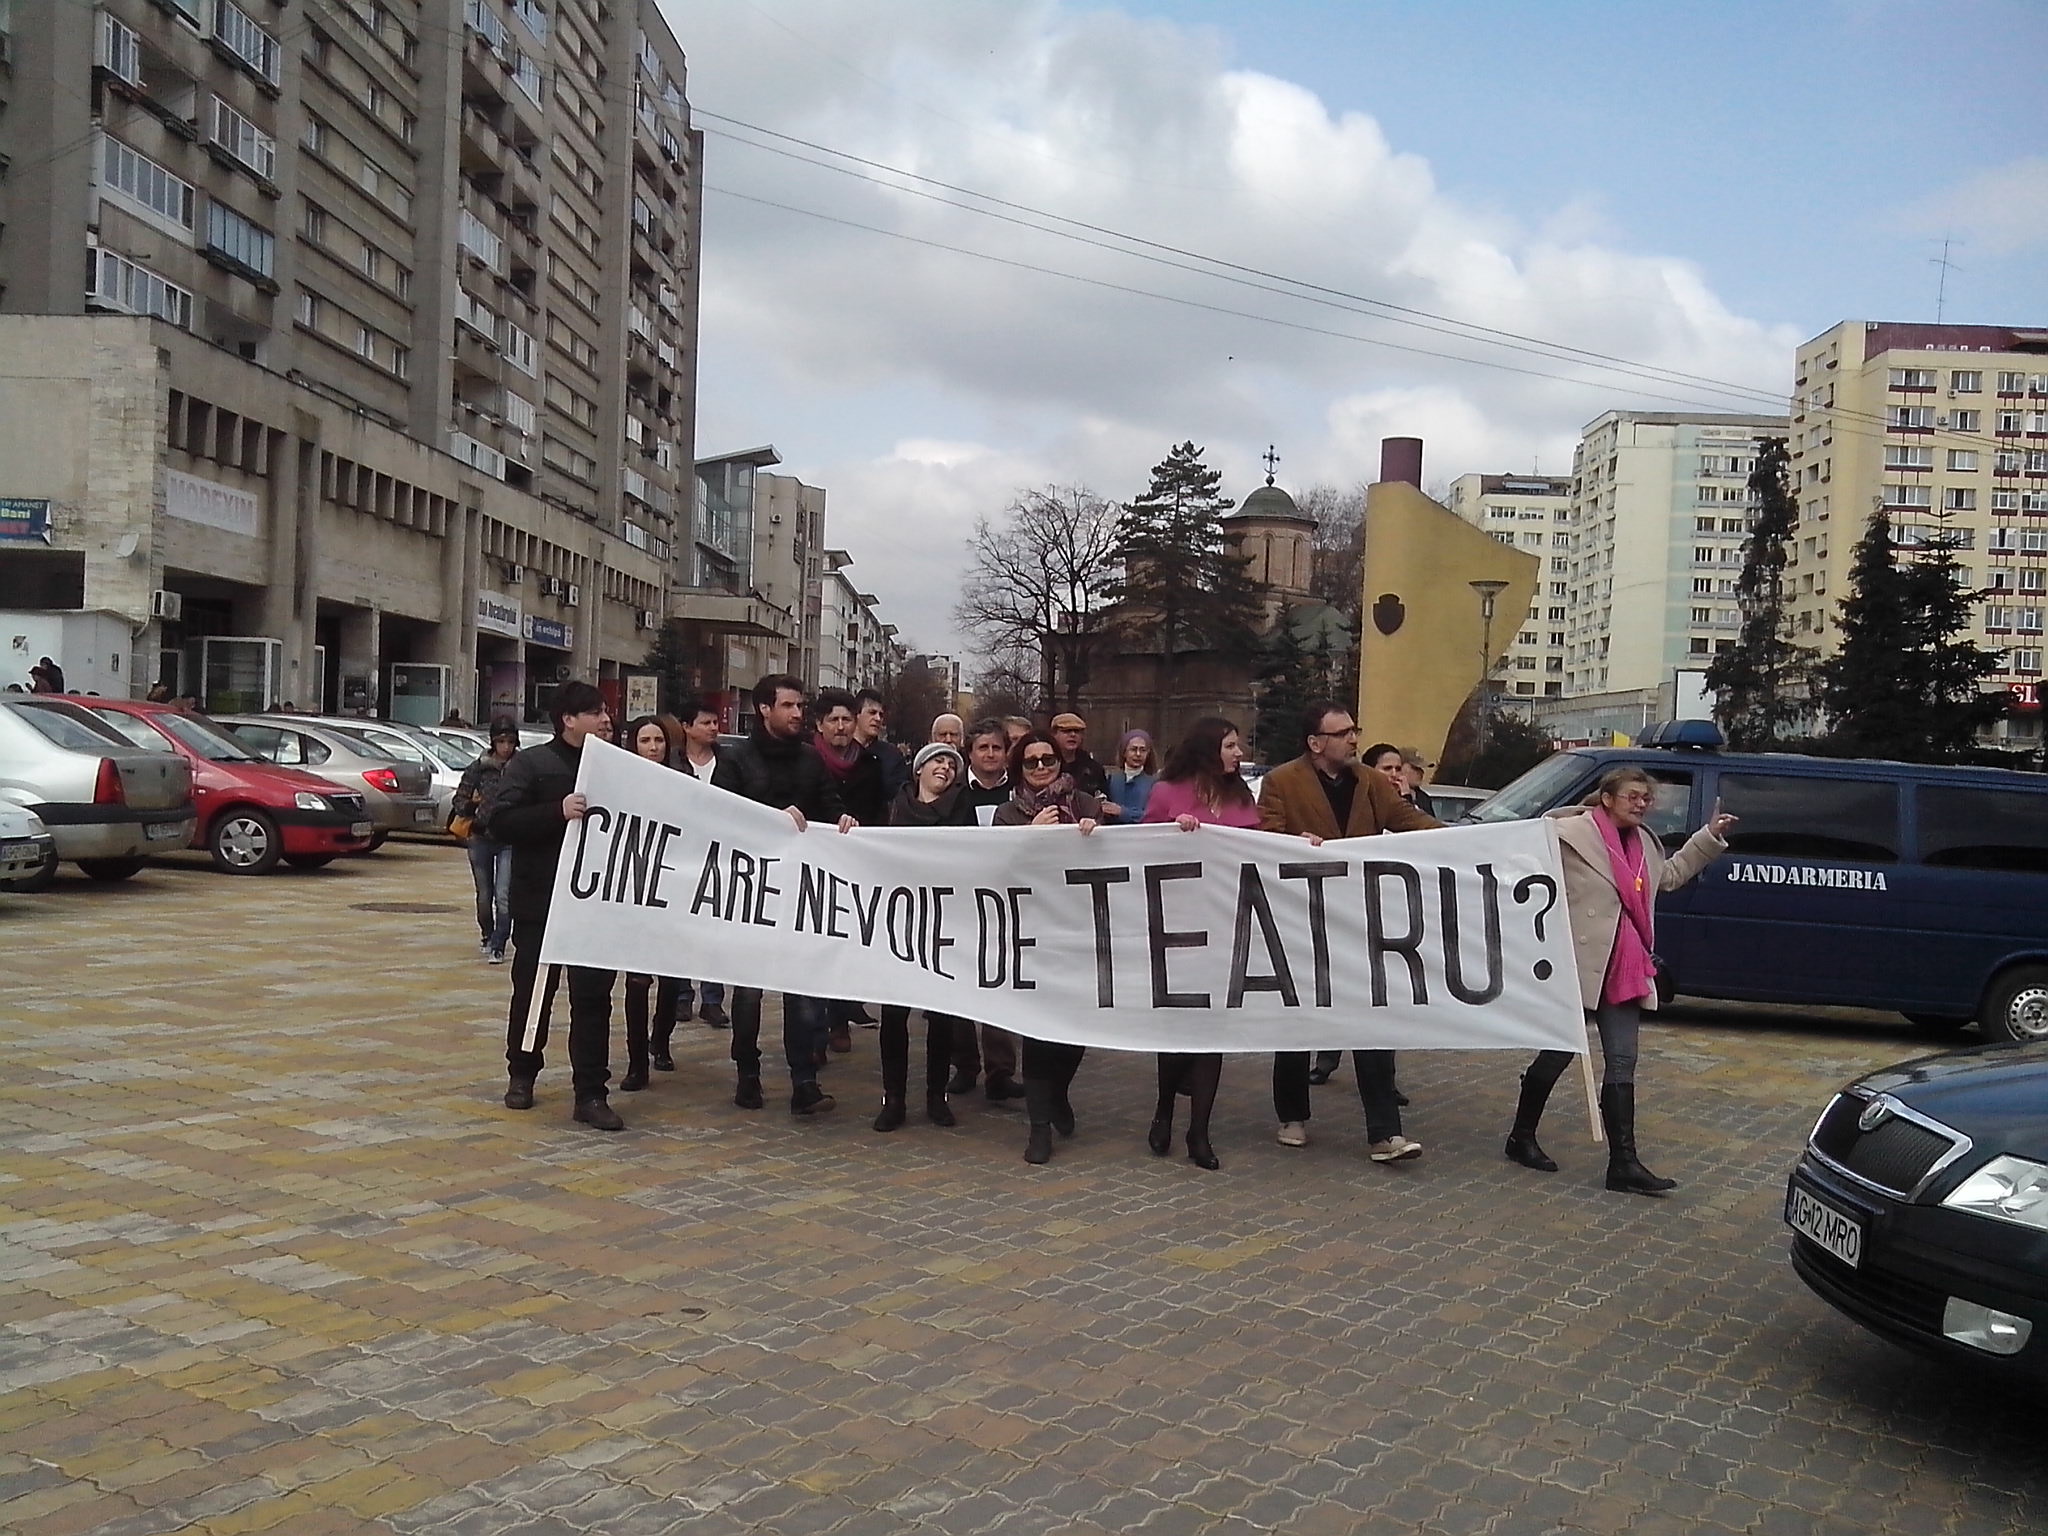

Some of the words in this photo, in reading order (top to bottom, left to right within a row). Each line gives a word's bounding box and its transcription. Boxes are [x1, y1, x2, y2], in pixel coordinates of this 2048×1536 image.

[1, 508, 31, 519] Bani
[1728, 862, 1887, 890] JANDARMERIA
[570, 806, 682, 908] CINE
[690, 840, 781, 927] ARE
[795, 862, 955, 980] NEVOIE
[974, 887, 1036, 989] DE
[1065, 861, 1557, 1008] TEATRU?
